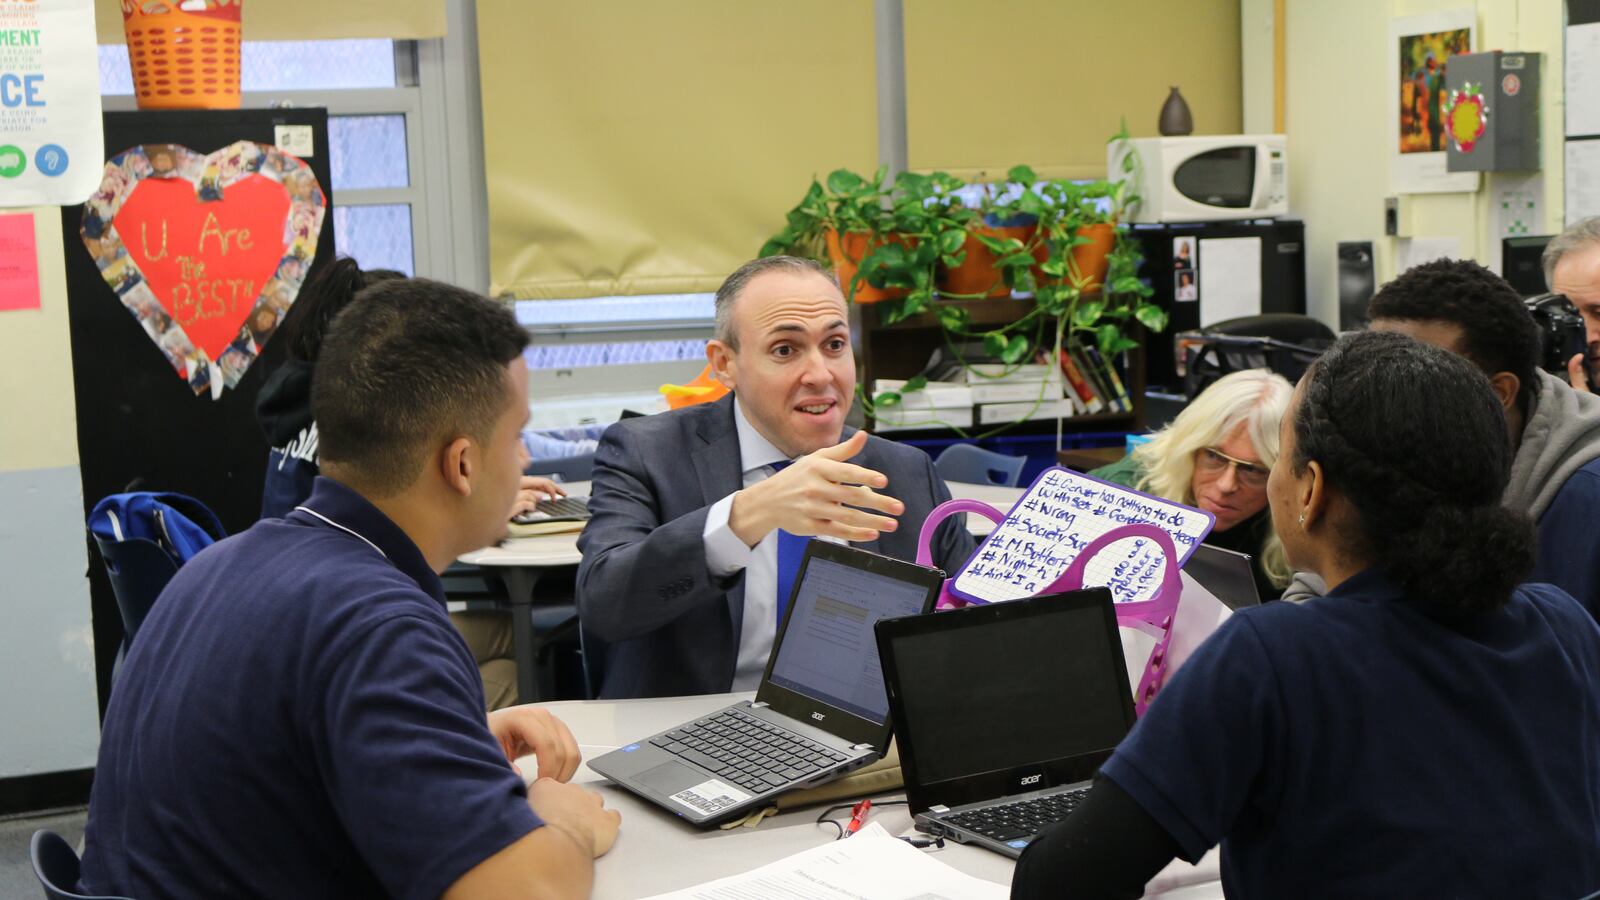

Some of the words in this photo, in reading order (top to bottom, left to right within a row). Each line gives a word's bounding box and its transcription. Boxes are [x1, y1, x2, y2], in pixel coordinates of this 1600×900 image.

[0, 74, 47, 107] CE
[142, 219, 168, 262] U
[199, 211, 254, 256] Are
[1099, 488, 1115, 504] has
[1153, 508, 1168, 521] to
[1167, 511, 1185, 527] do
[811, 711, 826, 721] acer
[1020, 774, 1042, 786] acer
